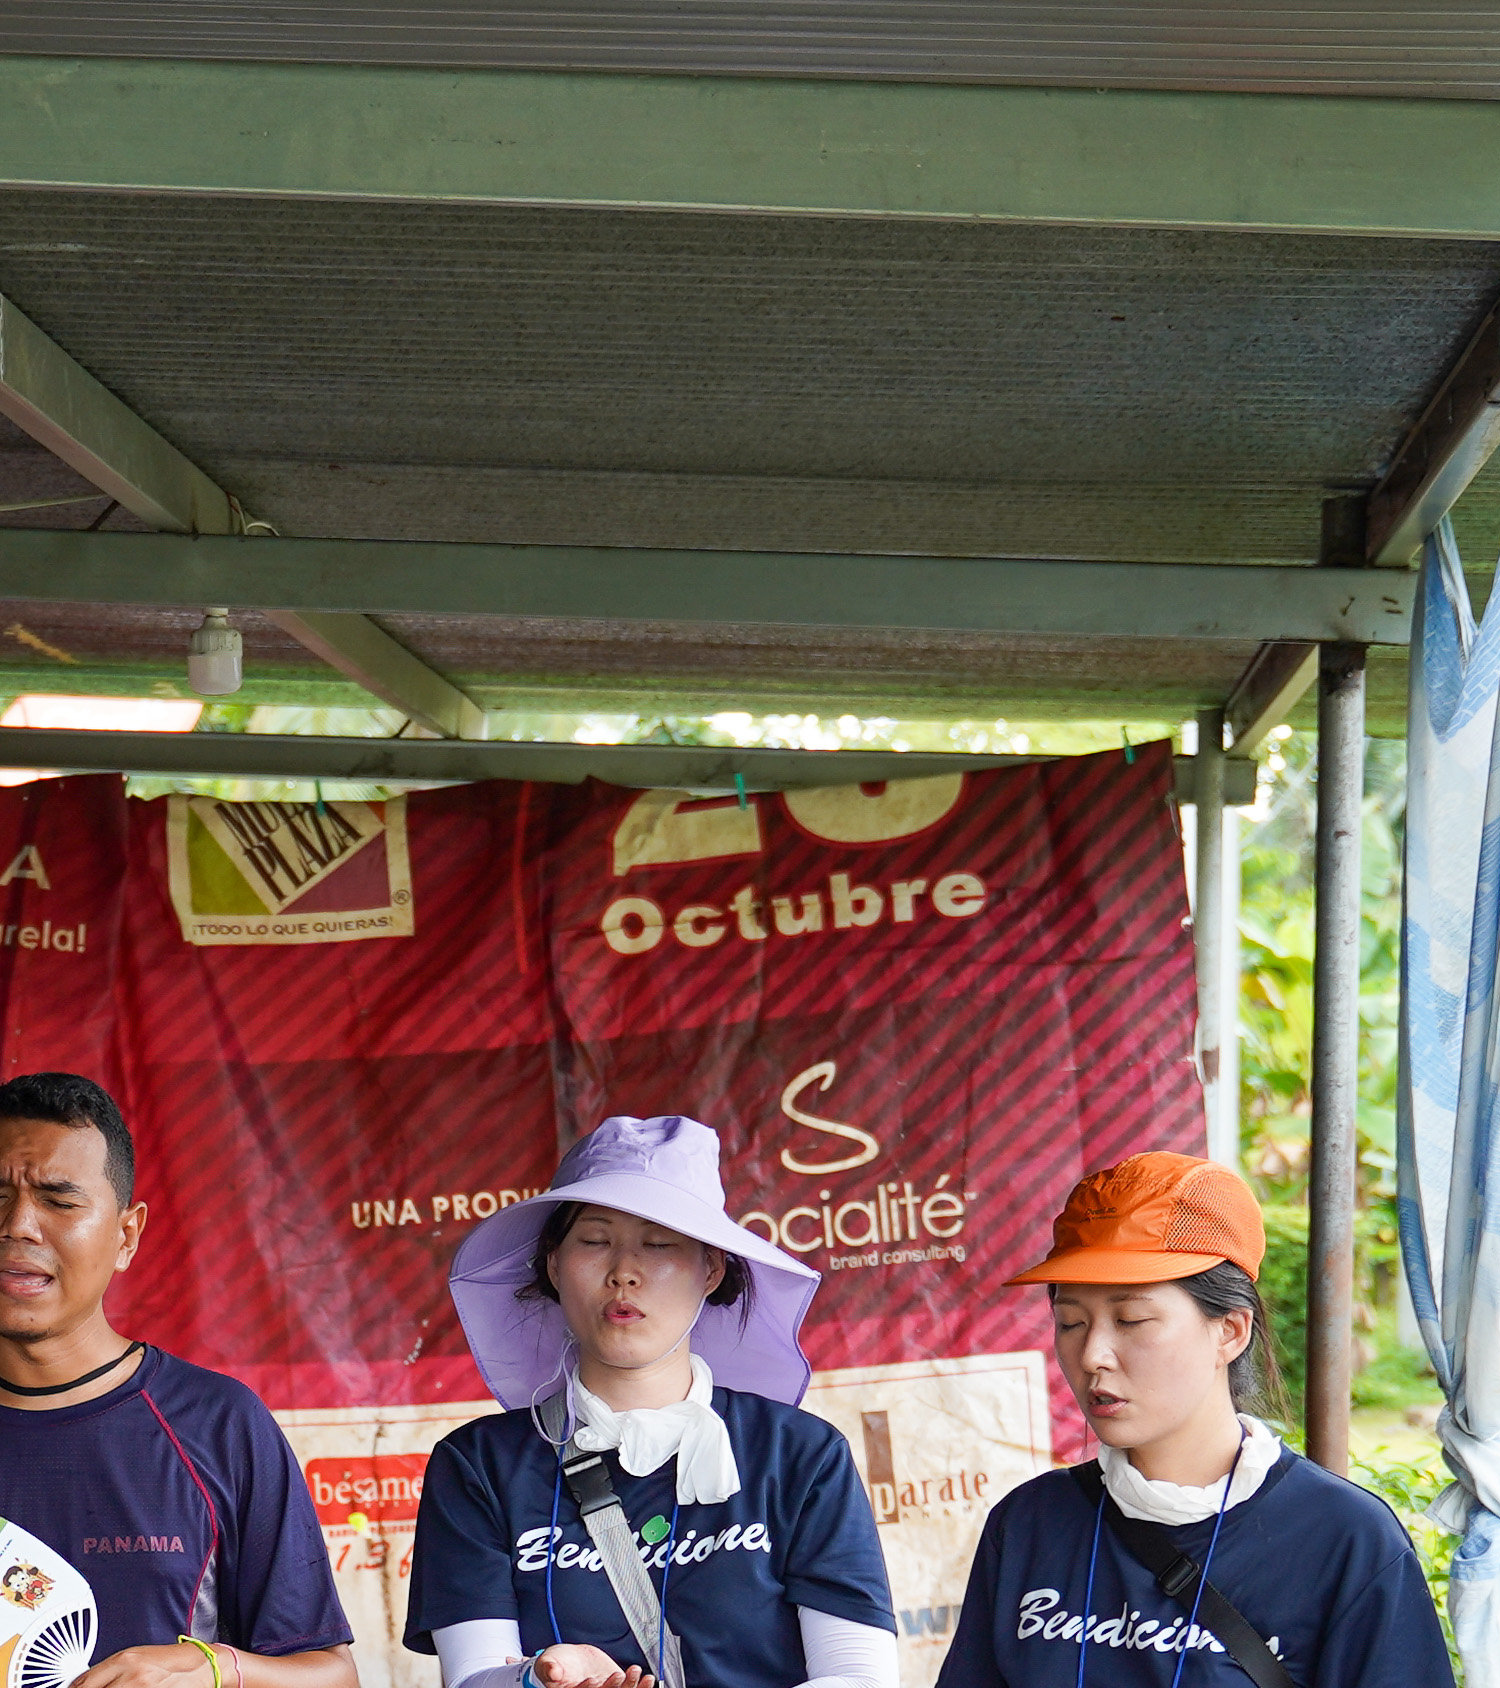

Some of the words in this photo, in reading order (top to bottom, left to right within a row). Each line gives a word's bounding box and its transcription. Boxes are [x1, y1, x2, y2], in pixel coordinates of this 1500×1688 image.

[242, 802, 366, 905] PLAZA
[246, 924, 268, 936] LO
[272, 922, 309, 936] QUE
[312, 916, 394, 934] QUIERAS!
[602, 871, 987, 955] Octubre
[781, 1060, 880, 1175] S
[351, 1198, 423, 1229] UNA
[431, 1188, 552, 1223] PROD
[736, 1173, 965, 1253] ocialité
[829, 1250, 879, 1271] brand
[882, 1244, 966, 1266] consulting
[83, 1535, 185, 1554] PANAMA
